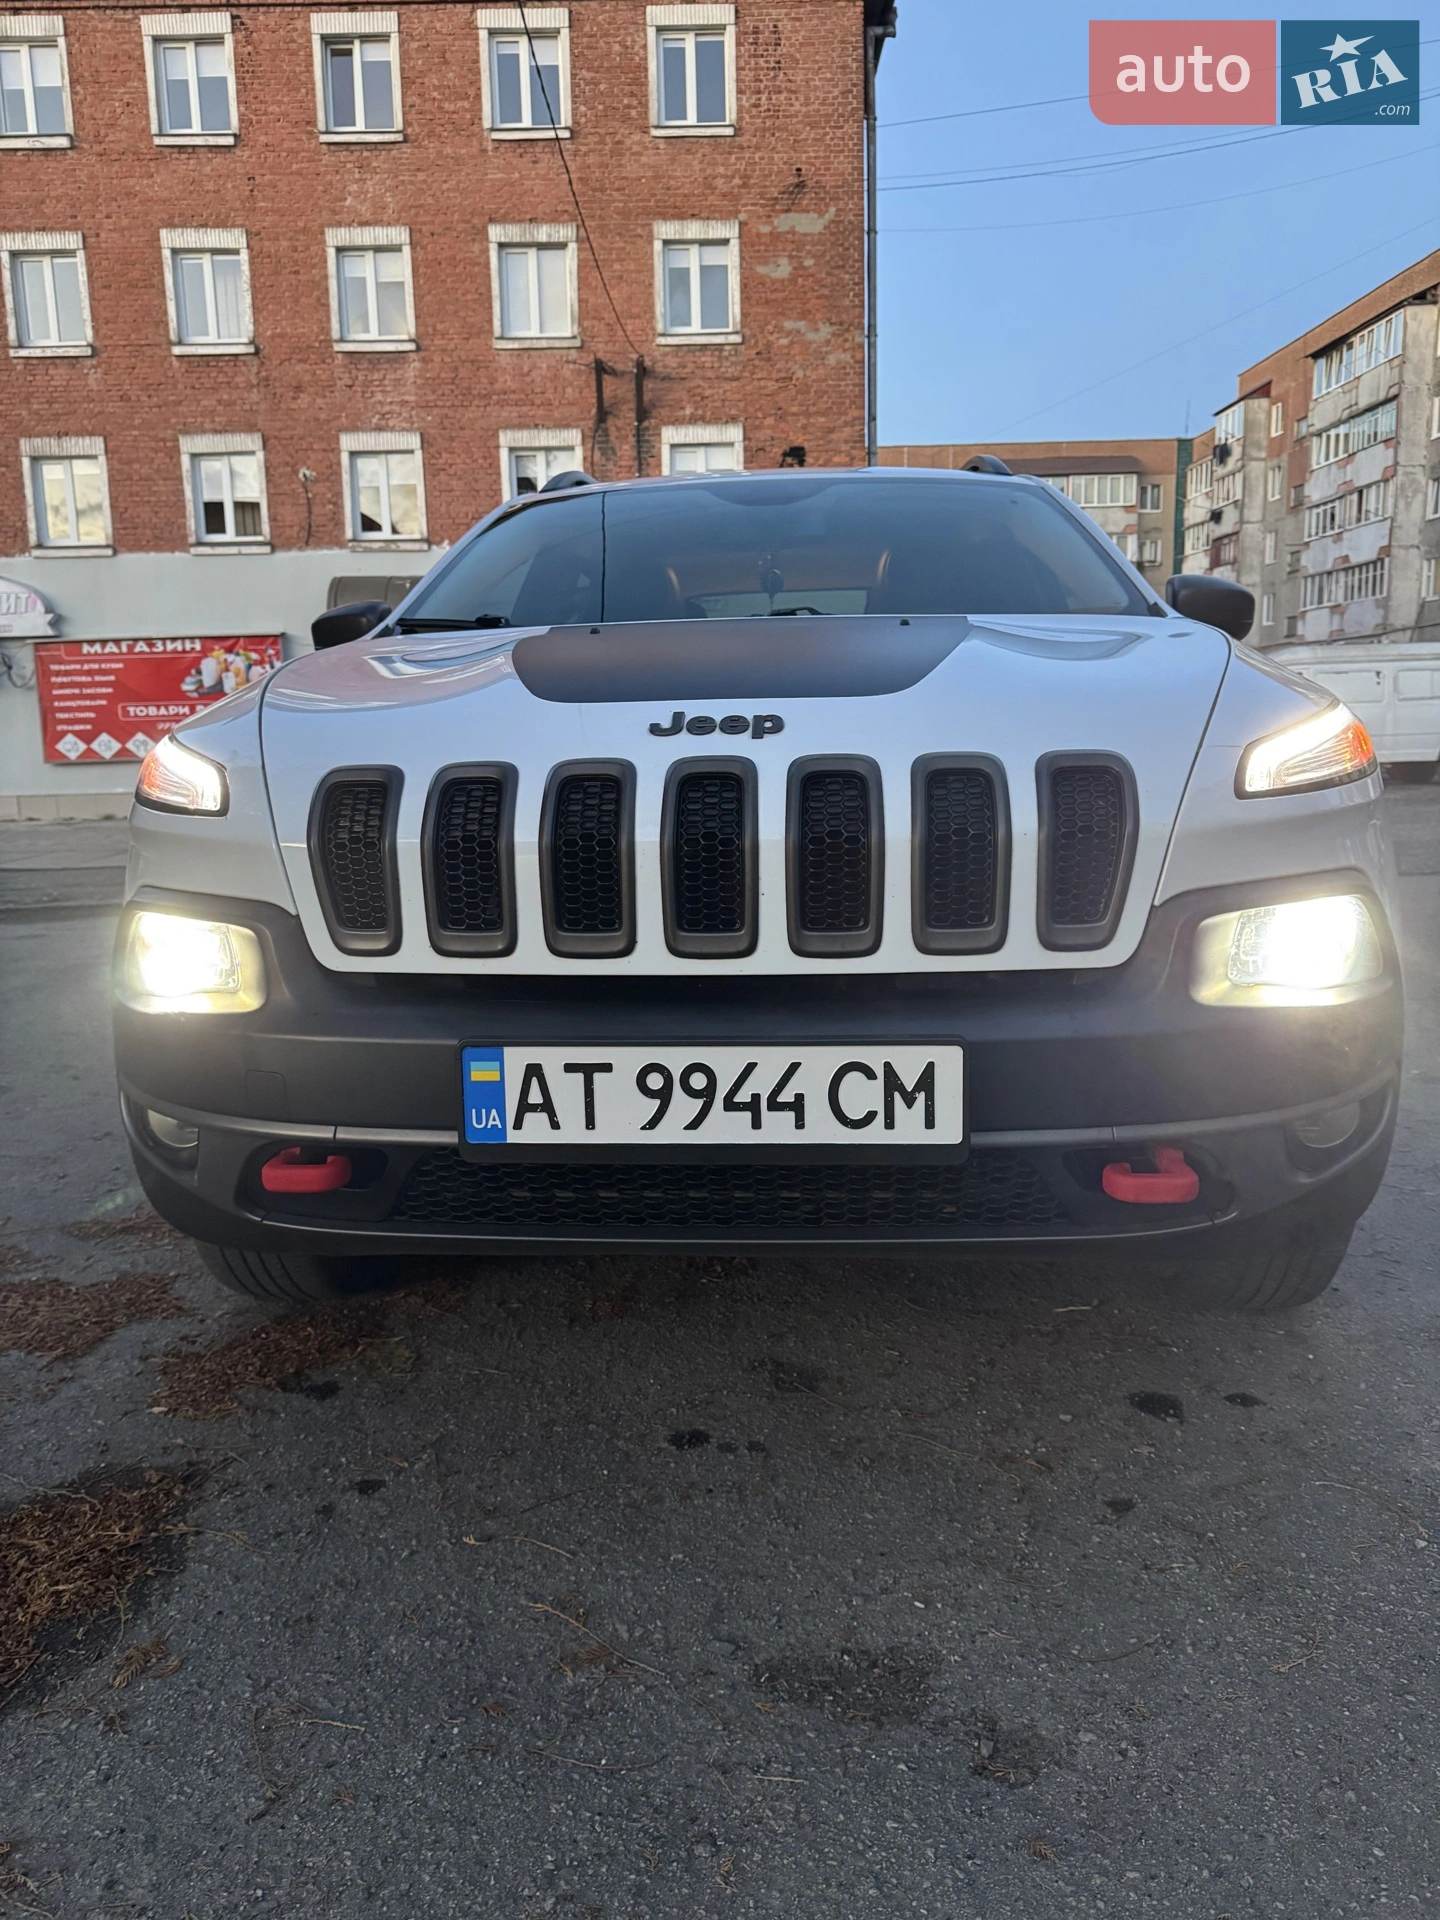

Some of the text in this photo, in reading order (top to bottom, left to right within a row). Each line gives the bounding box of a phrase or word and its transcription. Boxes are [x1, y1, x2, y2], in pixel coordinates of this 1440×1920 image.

[82, 638, 202, 655] МАГАЗИН
[126, 705, 190, 717] ТОВАРИ
[648, 711, 786, 739] Jeep
[513, 1060, 936, 1131] AT 9944 CM
[472, 1108, 502, 1129] UA
